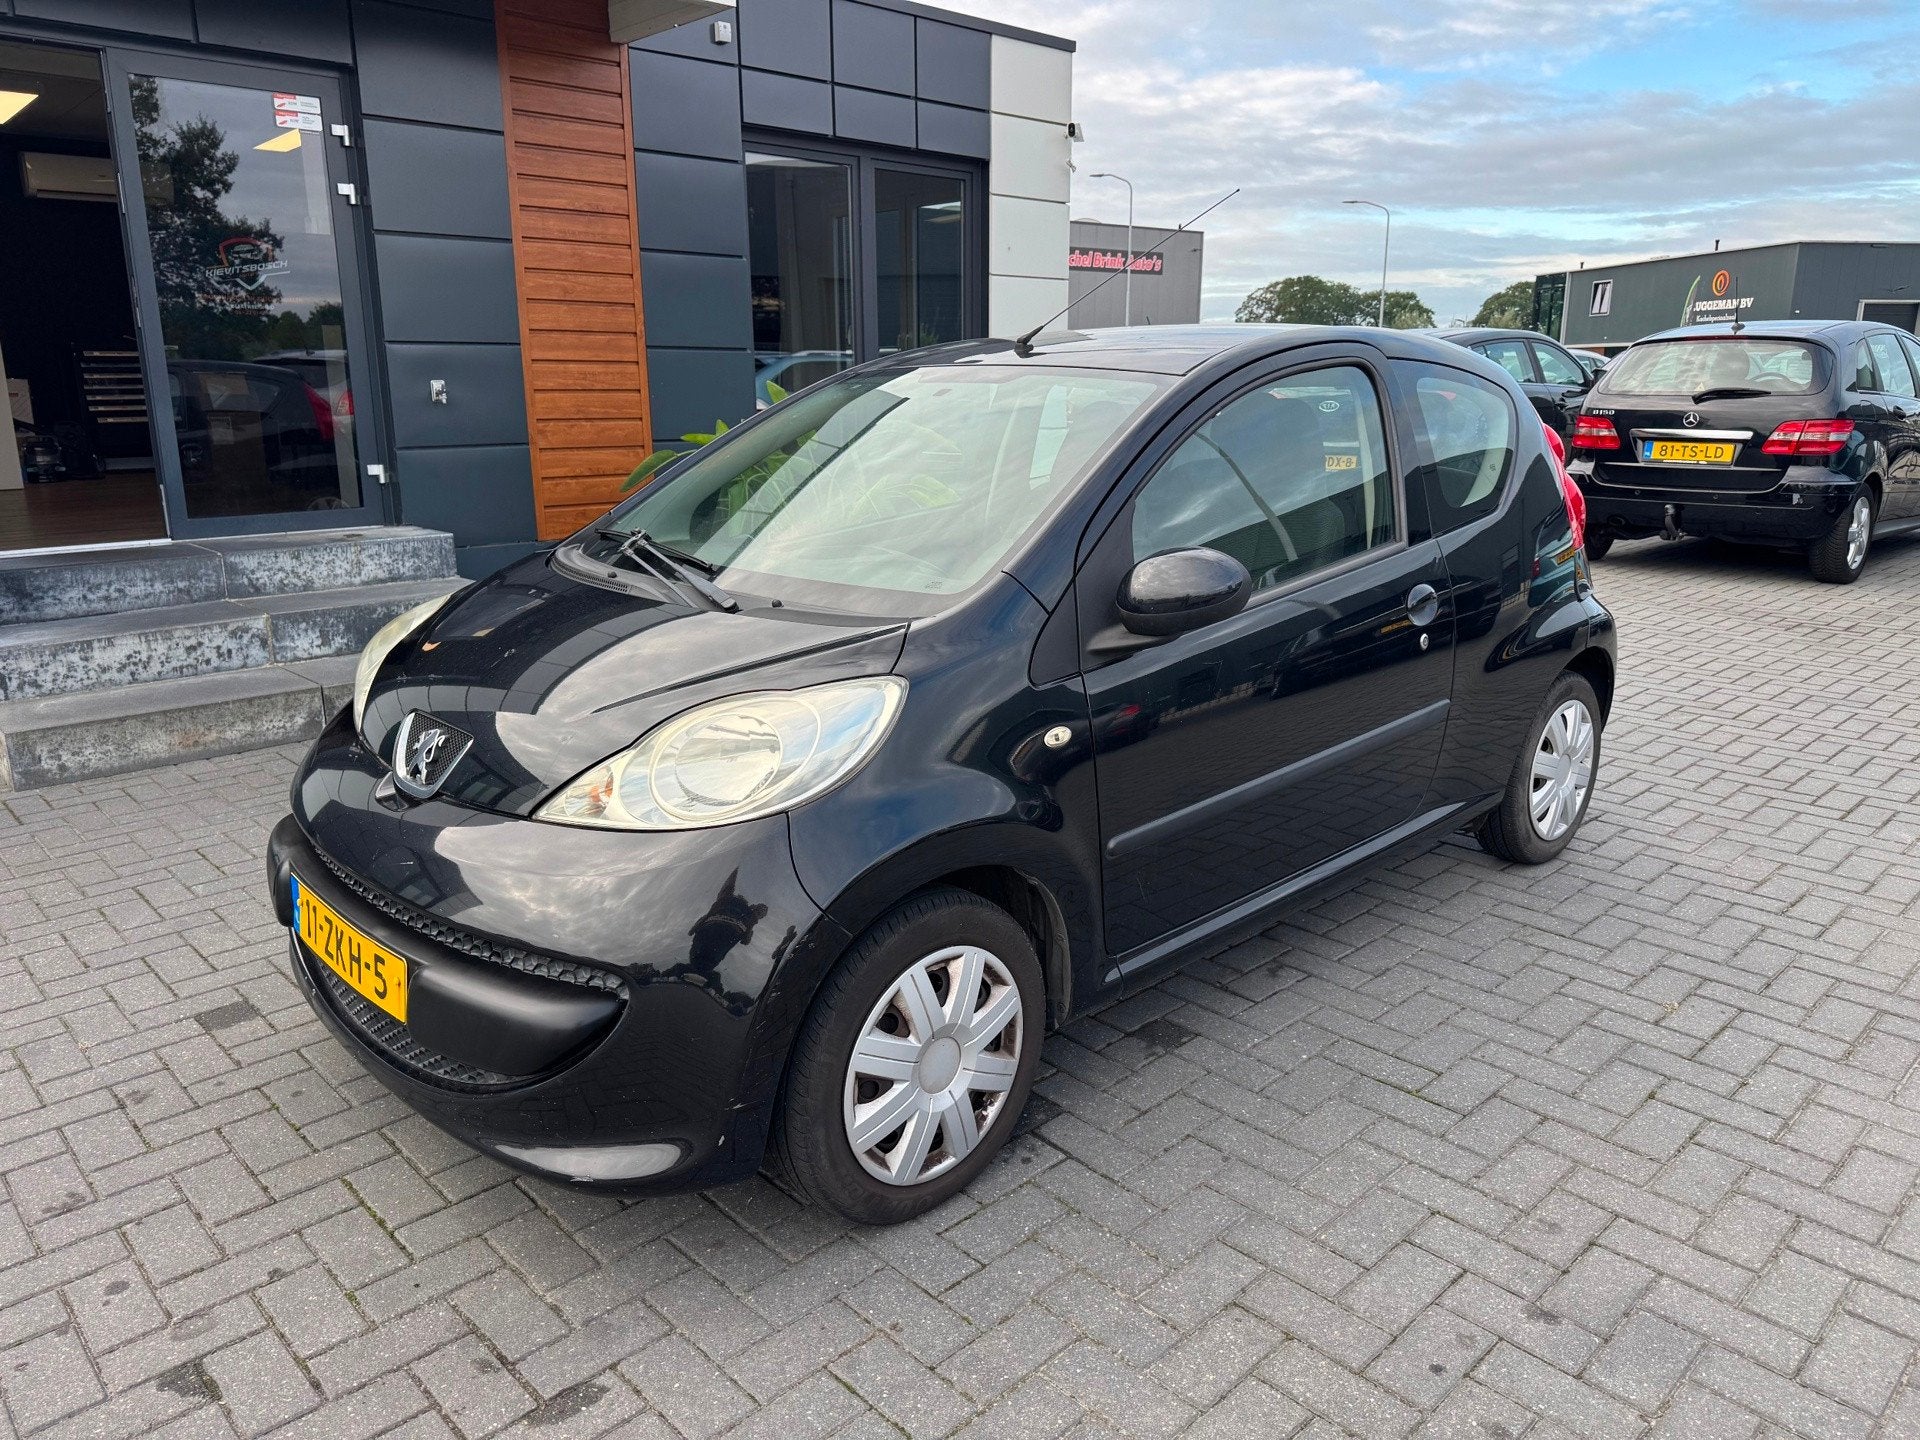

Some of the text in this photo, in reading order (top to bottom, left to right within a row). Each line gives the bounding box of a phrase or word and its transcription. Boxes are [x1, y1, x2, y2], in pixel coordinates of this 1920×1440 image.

[205, 260, 288, 278] KIEVITSBOSCH
[1093, 252, 1125, 269] Brink
[1693, 297, 1754, 312] UGGEMAN BV
[1659, 444, 1724, 459] 81-TS-LD
[306, 899, 388, 1000] 11-ZKH-5
